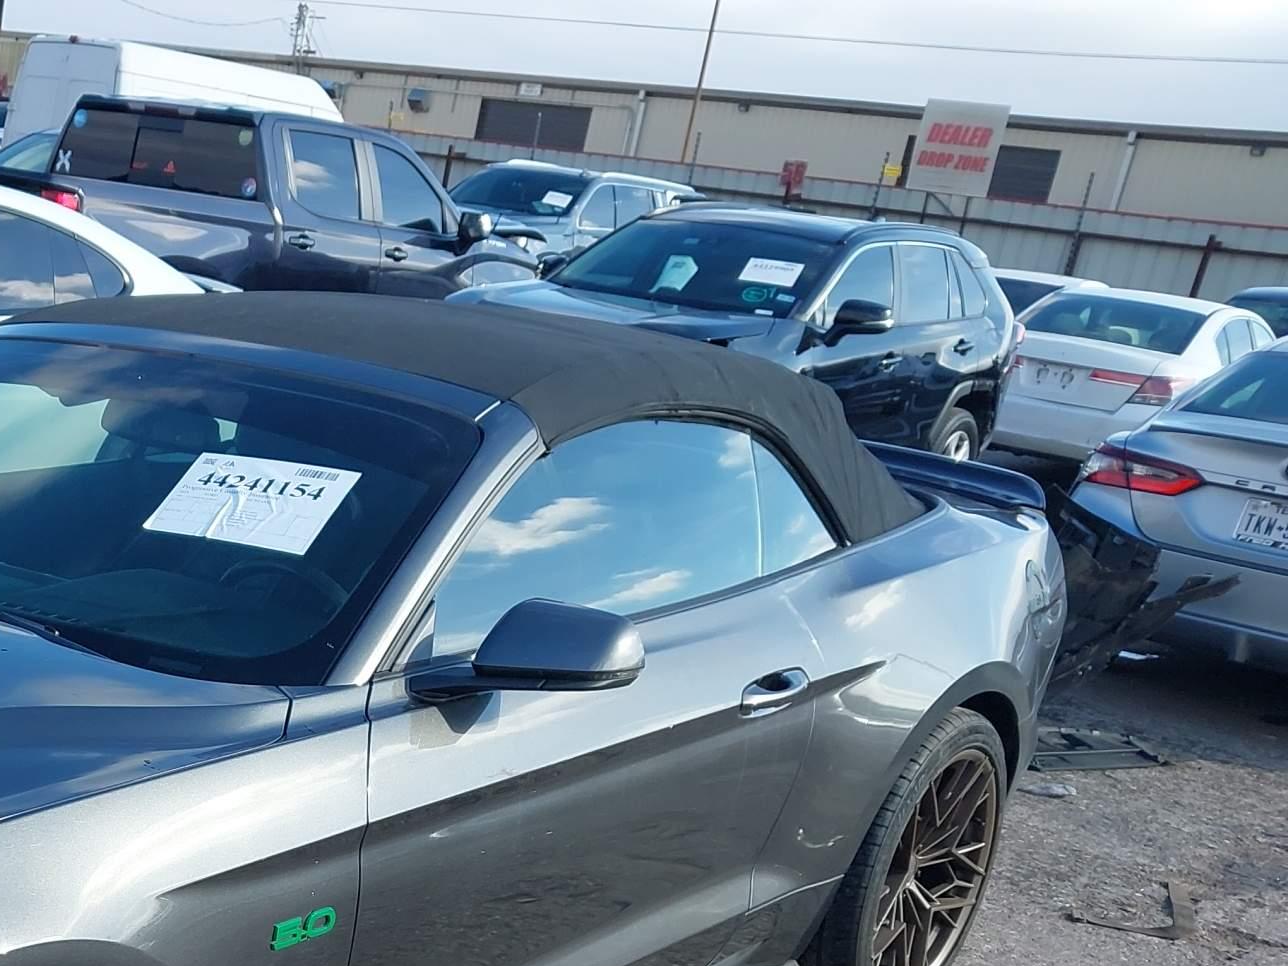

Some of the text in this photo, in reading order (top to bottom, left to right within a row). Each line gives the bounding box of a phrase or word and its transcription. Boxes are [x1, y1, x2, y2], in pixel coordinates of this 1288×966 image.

[926, 123, 993, 148] DEALER
[917, 150, 989, 173] DROP ZONE
[197, 471, 326, 501] 44241154
[270, 906, 337, 951] 5.0
